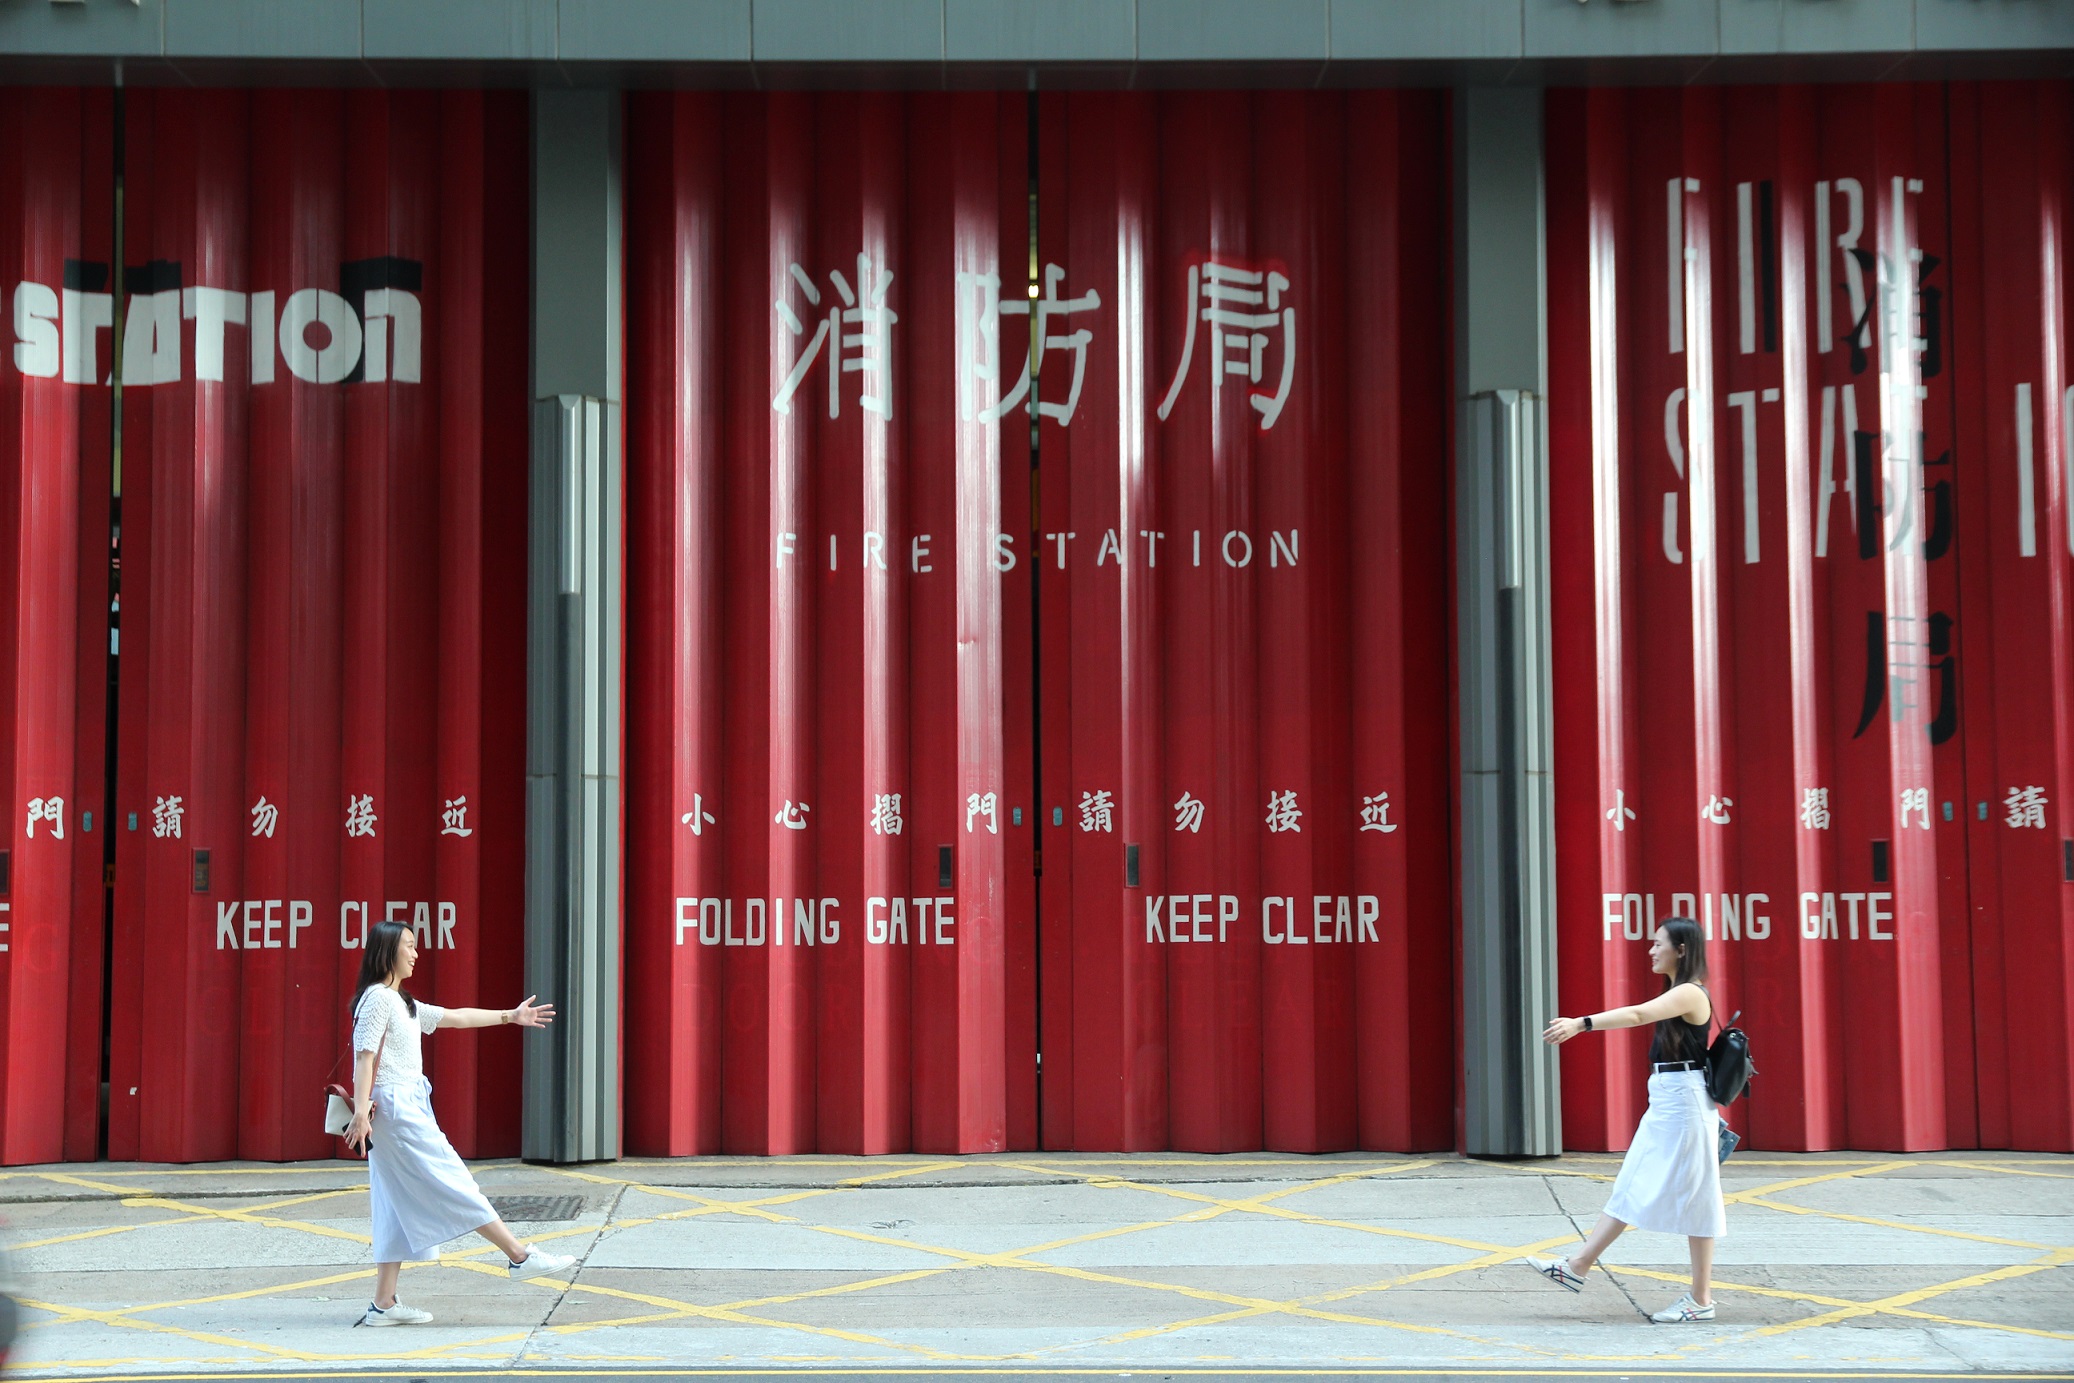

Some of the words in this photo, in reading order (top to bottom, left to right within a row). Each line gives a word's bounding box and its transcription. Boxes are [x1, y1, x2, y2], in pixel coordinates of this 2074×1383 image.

[1667, 176, 1928, 354] FIRE
[773, 252, 1296, 430] 消防局
[1663, 382, 2074, 565] STATI
[1839, 247, 1957, 746] 消防局
[774, 530, 933, 572] FIRE
[993, 528, 1299, 573] STATION
[26, 796, 65, 840] 門
[152, 794, 473, 839] 請勿接近
[2003, 785, 2049, 829] 請
[216, 899, 313, 950] KEEP
[676, 897, 840, 946] FOLDING
[866, 896, 955, 945] GATE
[1146, 894, 1239, 943] KEEP
[1262, 895, 1379, 945] CLEAR
[1801, 891, 1893, 940] GATE
